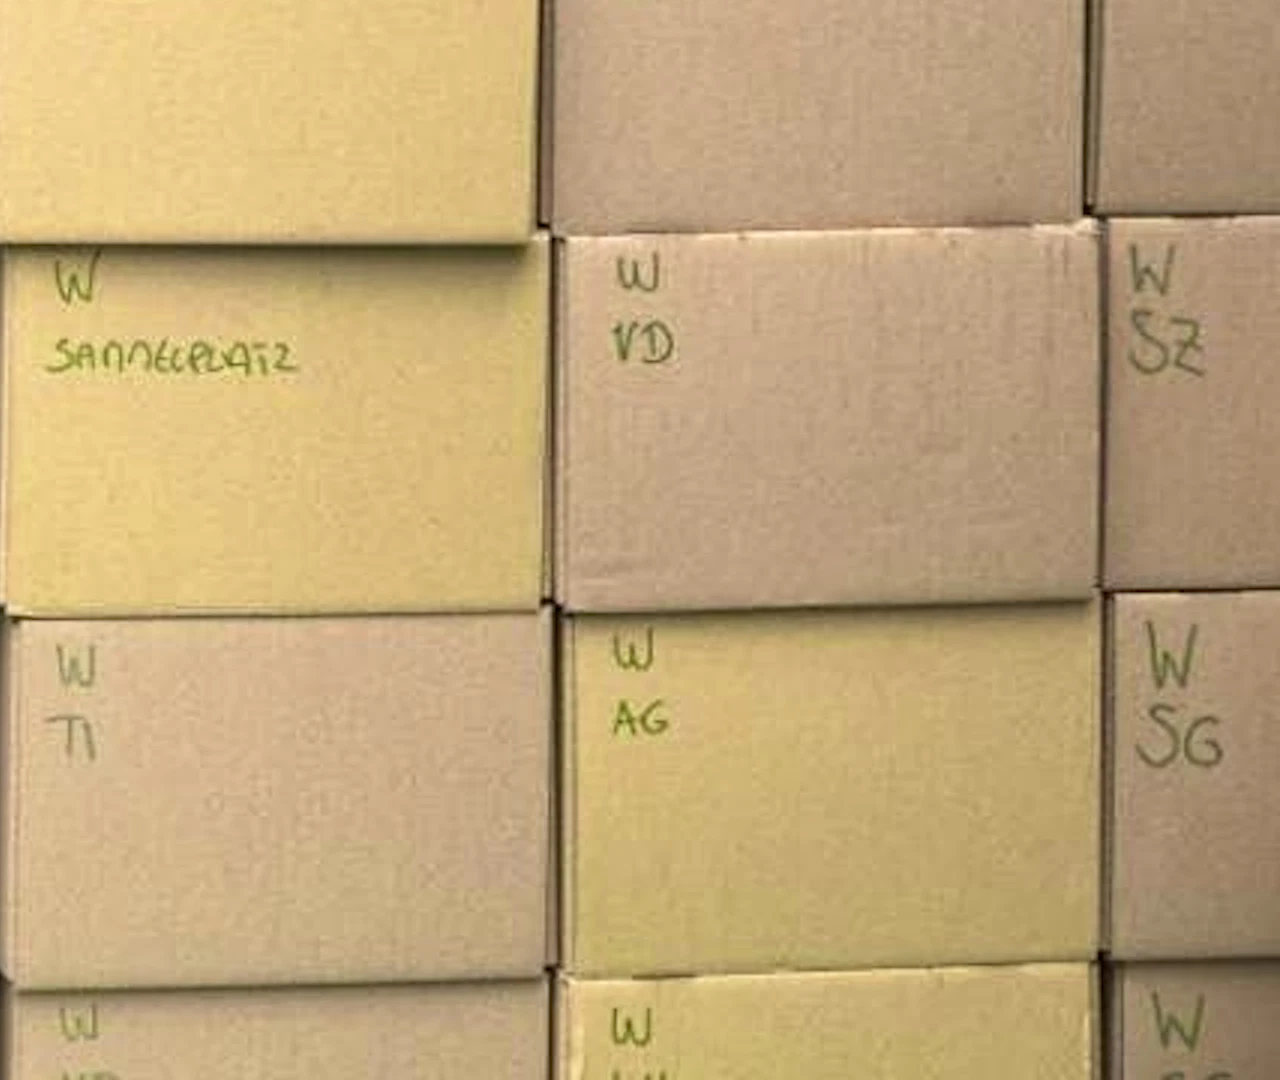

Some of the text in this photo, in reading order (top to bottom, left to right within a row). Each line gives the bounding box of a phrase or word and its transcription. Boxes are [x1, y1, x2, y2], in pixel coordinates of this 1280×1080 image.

[53, 251, 100, 302] W
[617, 253, 659, 293] W
[1128, 245, 1176, 296] W
[613, 321, 673, 364] VD
[1128, 311, 1204, 376] SZ
[57, 645, 95, 688] W
[612, 624, 655, 672] W
[1146, 621, 1197, 690] W
[45, 715, 96, 761] TI
[613, 700, 668, 735] AG
[1136, 703, 1223, 769] SG
[59, 1000, 100, 1042] W
[611, 1008, 652, 1046] W
[1153, 993, 1204, 1051] W
